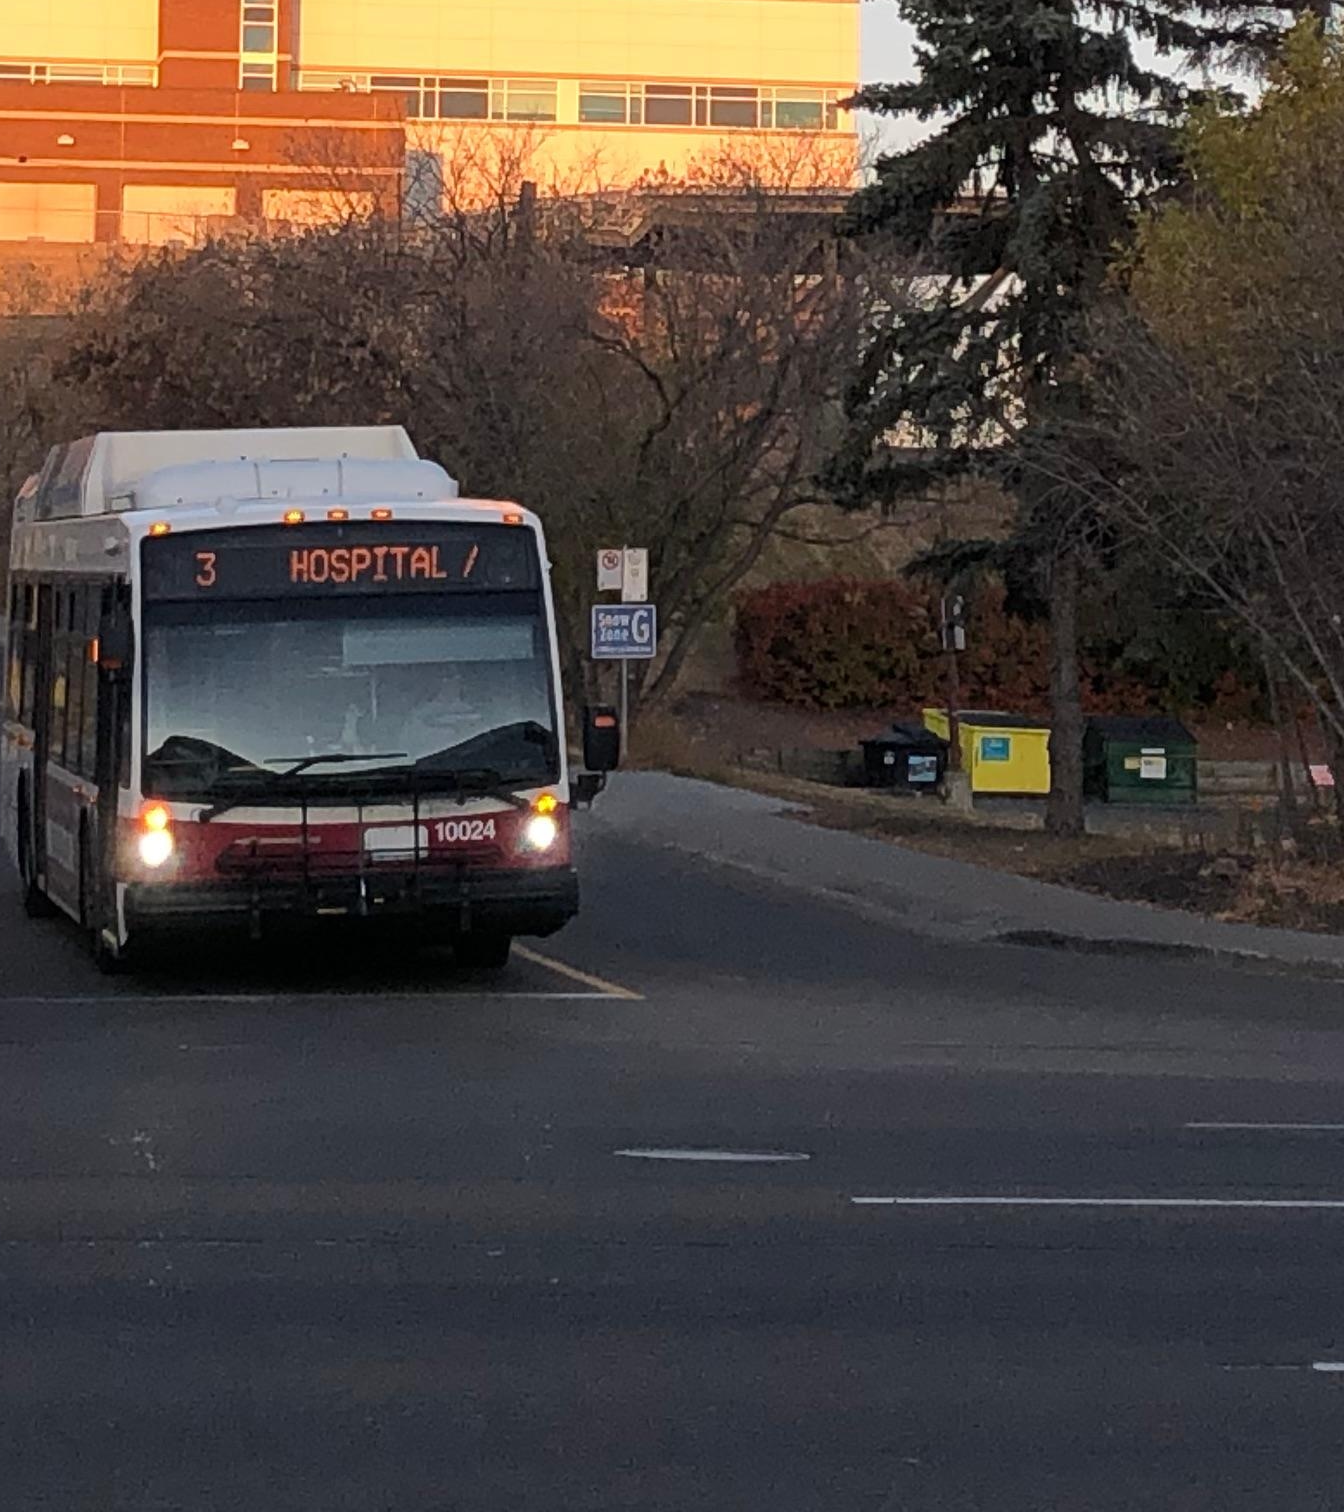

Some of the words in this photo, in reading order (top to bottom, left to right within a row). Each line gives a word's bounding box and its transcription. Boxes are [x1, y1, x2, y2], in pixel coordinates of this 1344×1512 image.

[195, 551, 216, 587] 3
[289, 546, 448, 584] HOSPITAL
[463, 544, 479, 578] /
[631, 609, 650, 644] G
[434, 818, 497, 842] 10024
